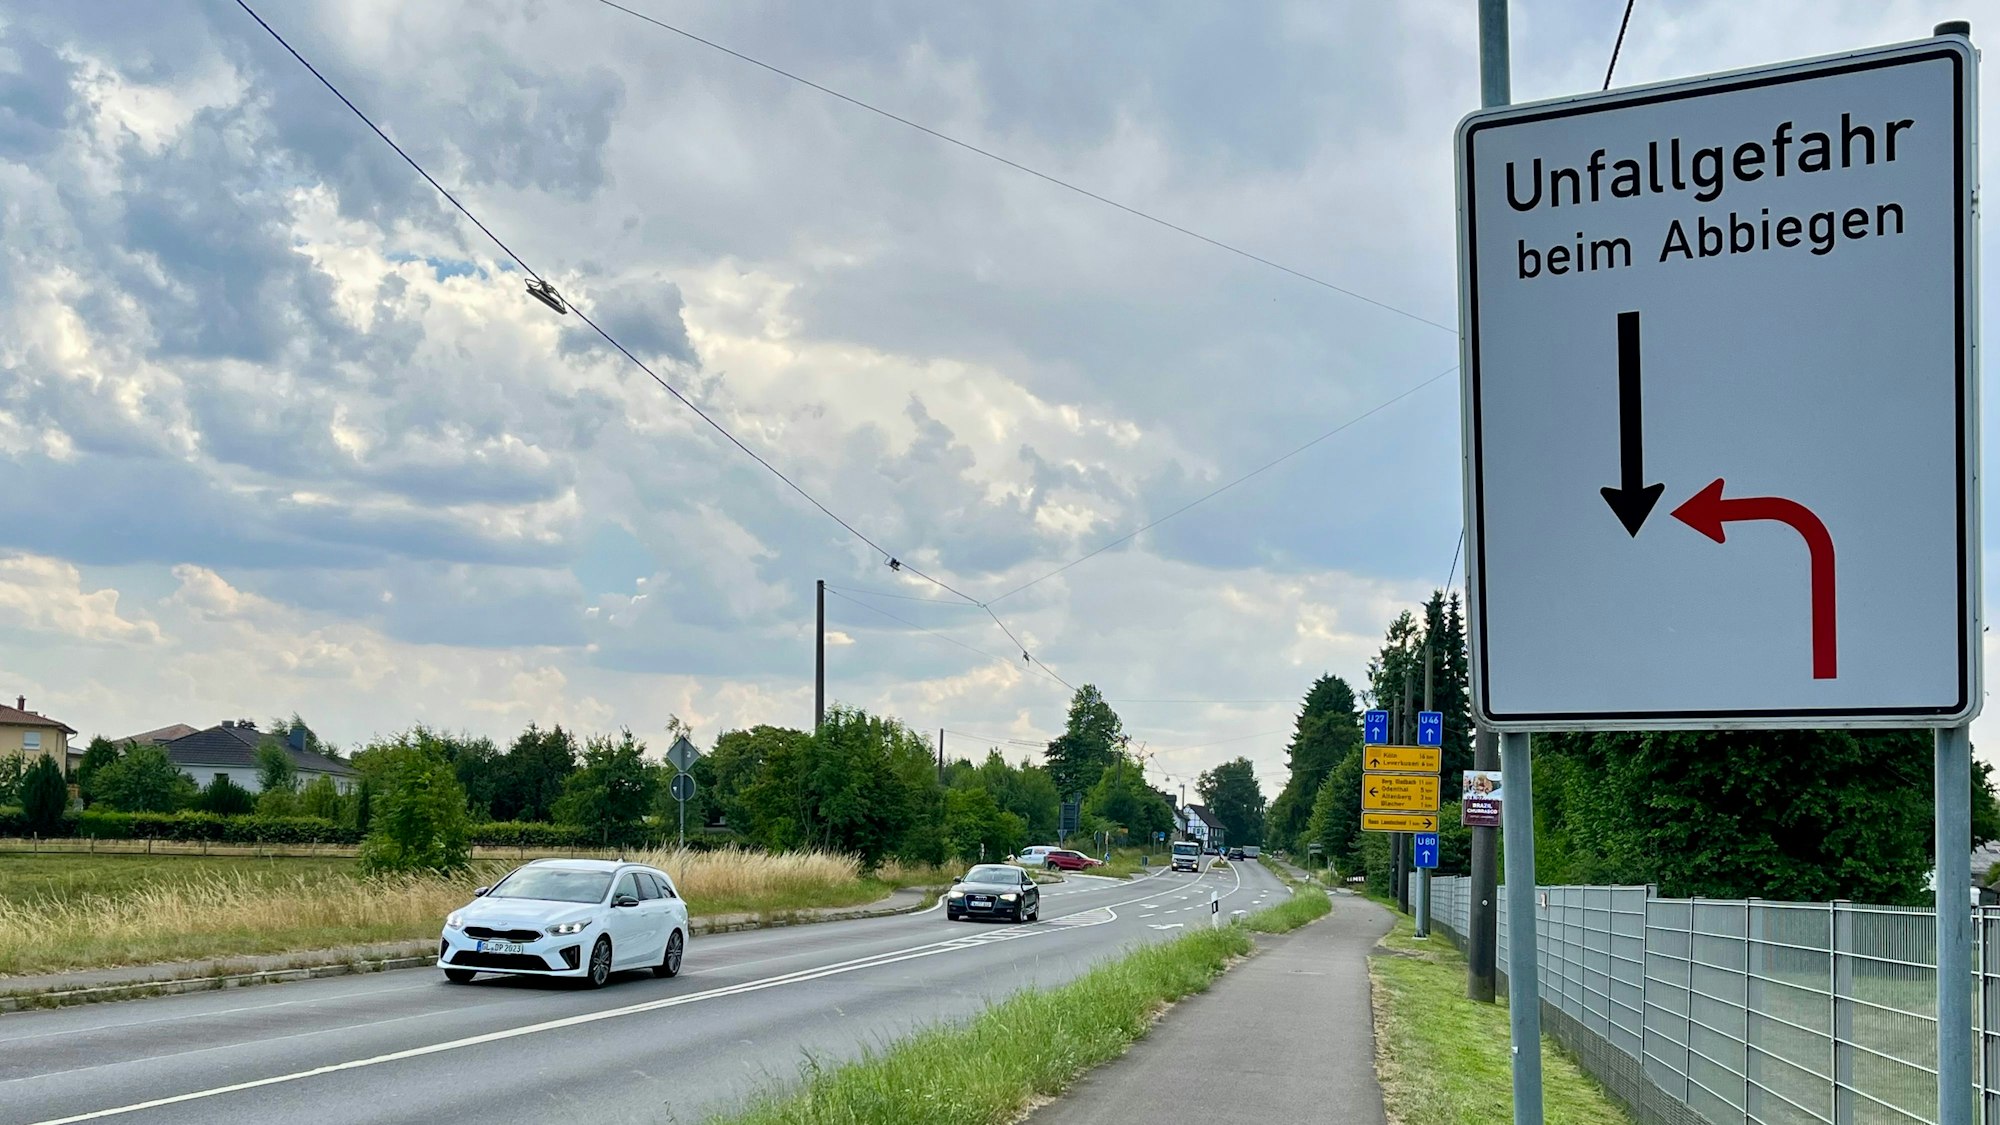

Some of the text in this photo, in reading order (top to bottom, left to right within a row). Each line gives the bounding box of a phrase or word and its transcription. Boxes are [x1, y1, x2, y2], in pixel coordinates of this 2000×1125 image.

[1506, 113, 1914, 211] Unfallgefahr
[1518, 204, 1903, 279] beim Abbiegen
